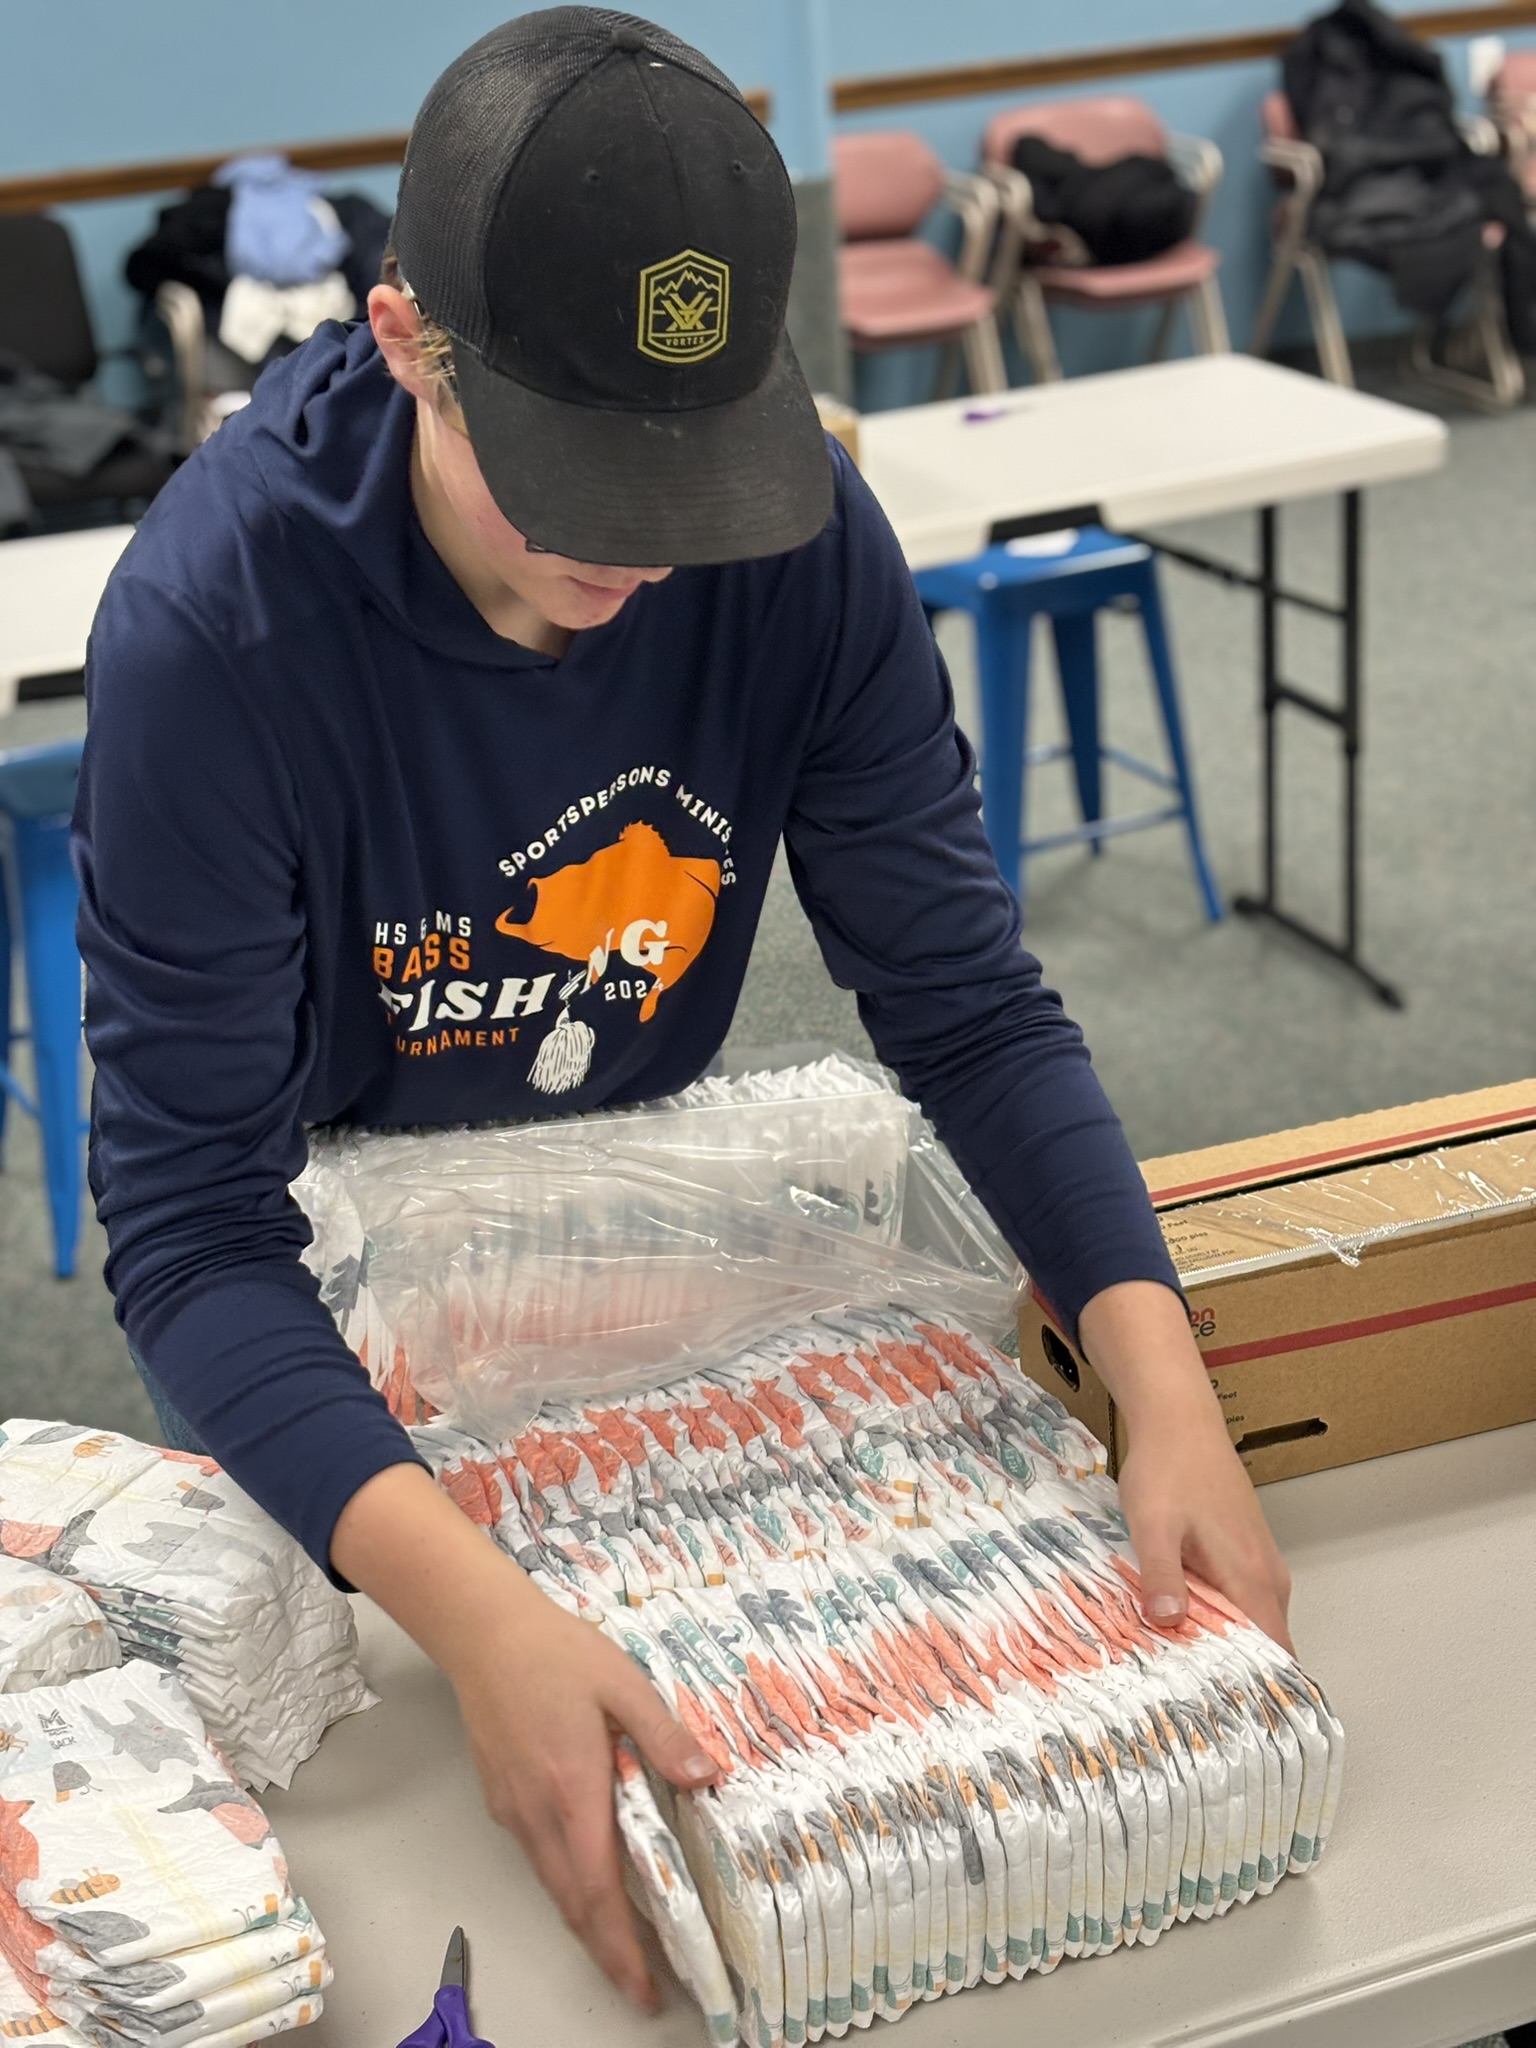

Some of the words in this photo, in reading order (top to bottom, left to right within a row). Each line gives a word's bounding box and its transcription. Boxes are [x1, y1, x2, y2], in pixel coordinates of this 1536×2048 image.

[375, 922, 407, 945] HS
[435, 910, 472, 937] MS
[373, 932, 471, 984] BASS
